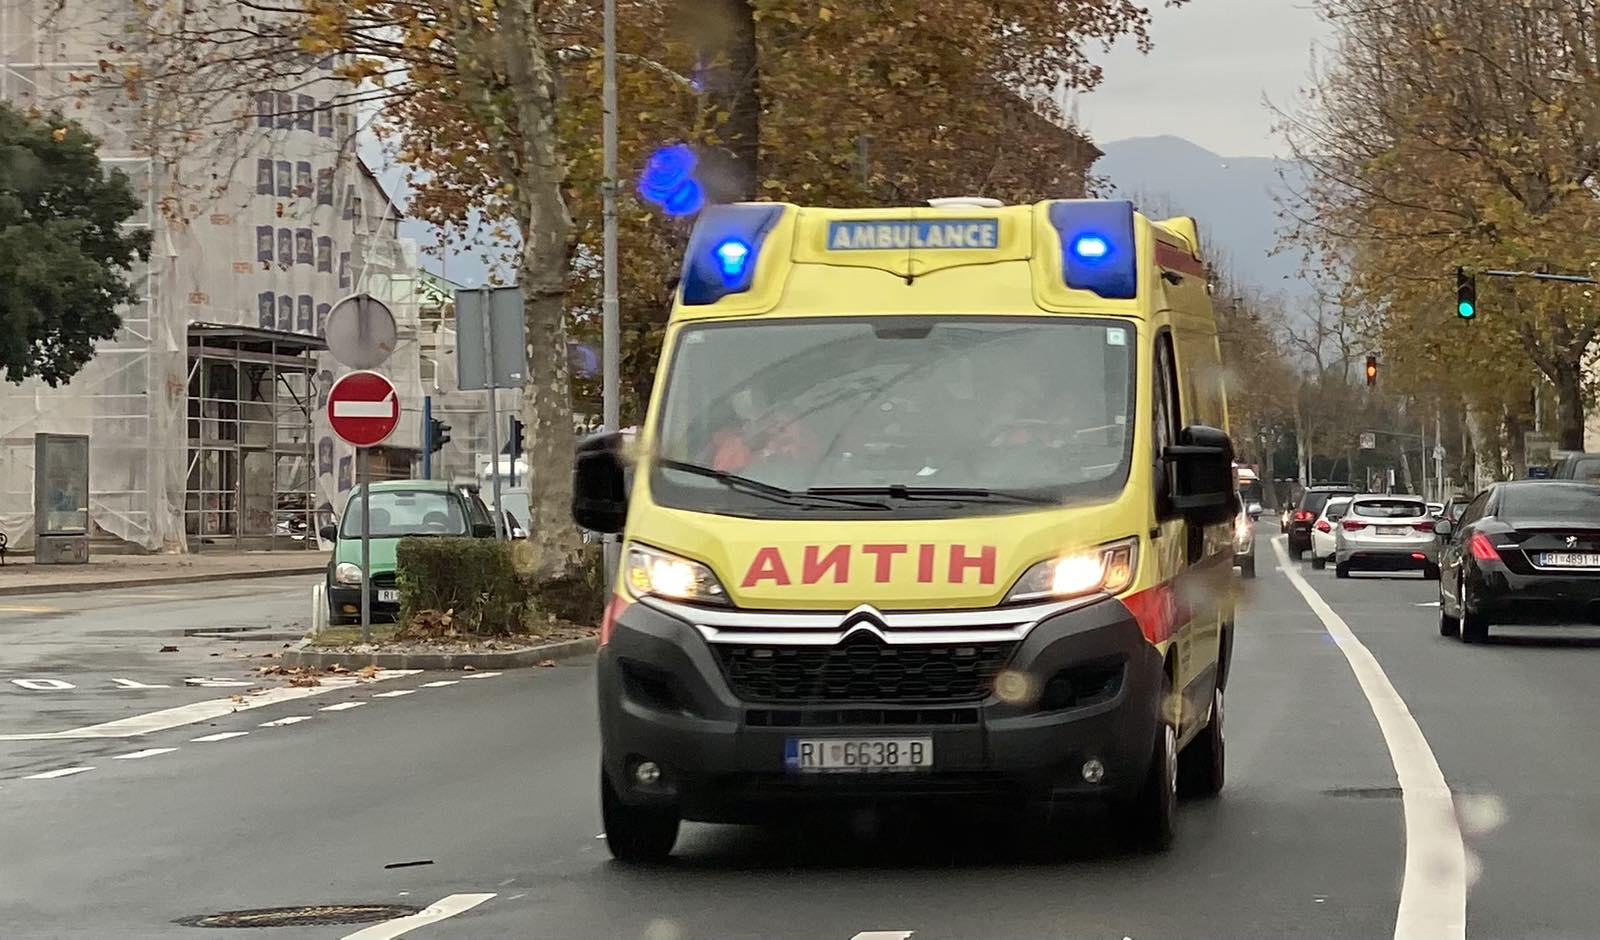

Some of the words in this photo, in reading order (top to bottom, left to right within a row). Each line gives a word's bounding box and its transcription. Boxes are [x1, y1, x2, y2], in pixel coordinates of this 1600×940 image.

[832, 224, 995, 249] AMBULANCE
[1547, 553, 1559, 565] RI
[383, 590, 394, 600] RI
[801, 742, 825, 766] RI
[844, 742, 924, 766] 6638-B
